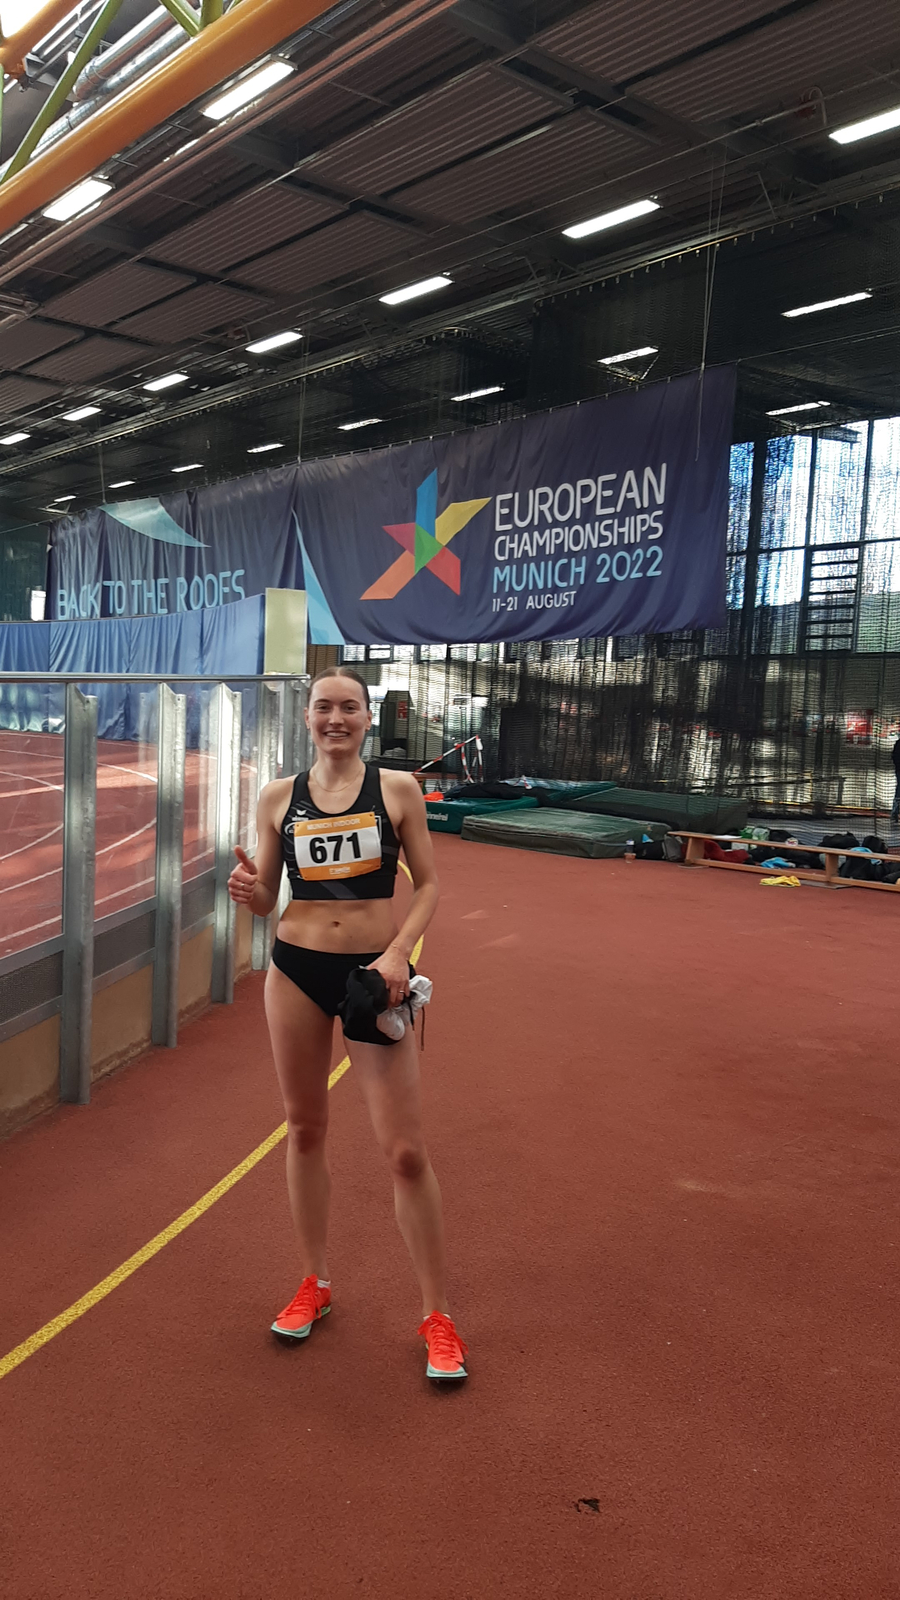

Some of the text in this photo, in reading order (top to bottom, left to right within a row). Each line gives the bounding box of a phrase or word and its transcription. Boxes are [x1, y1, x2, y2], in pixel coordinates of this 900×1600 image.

[495, 463, 667, 532] EUROPEAN
[494, 510, 664, 561] CHAMPIONSHIPS
[492, 546, 663, 593] MUNICH 2022
[57, 569, 245, 620] BACK TO THE ROOFS
[492, 591, 577, 612] 11-21 AUGUST
[309, 832, 361, 864] 671
